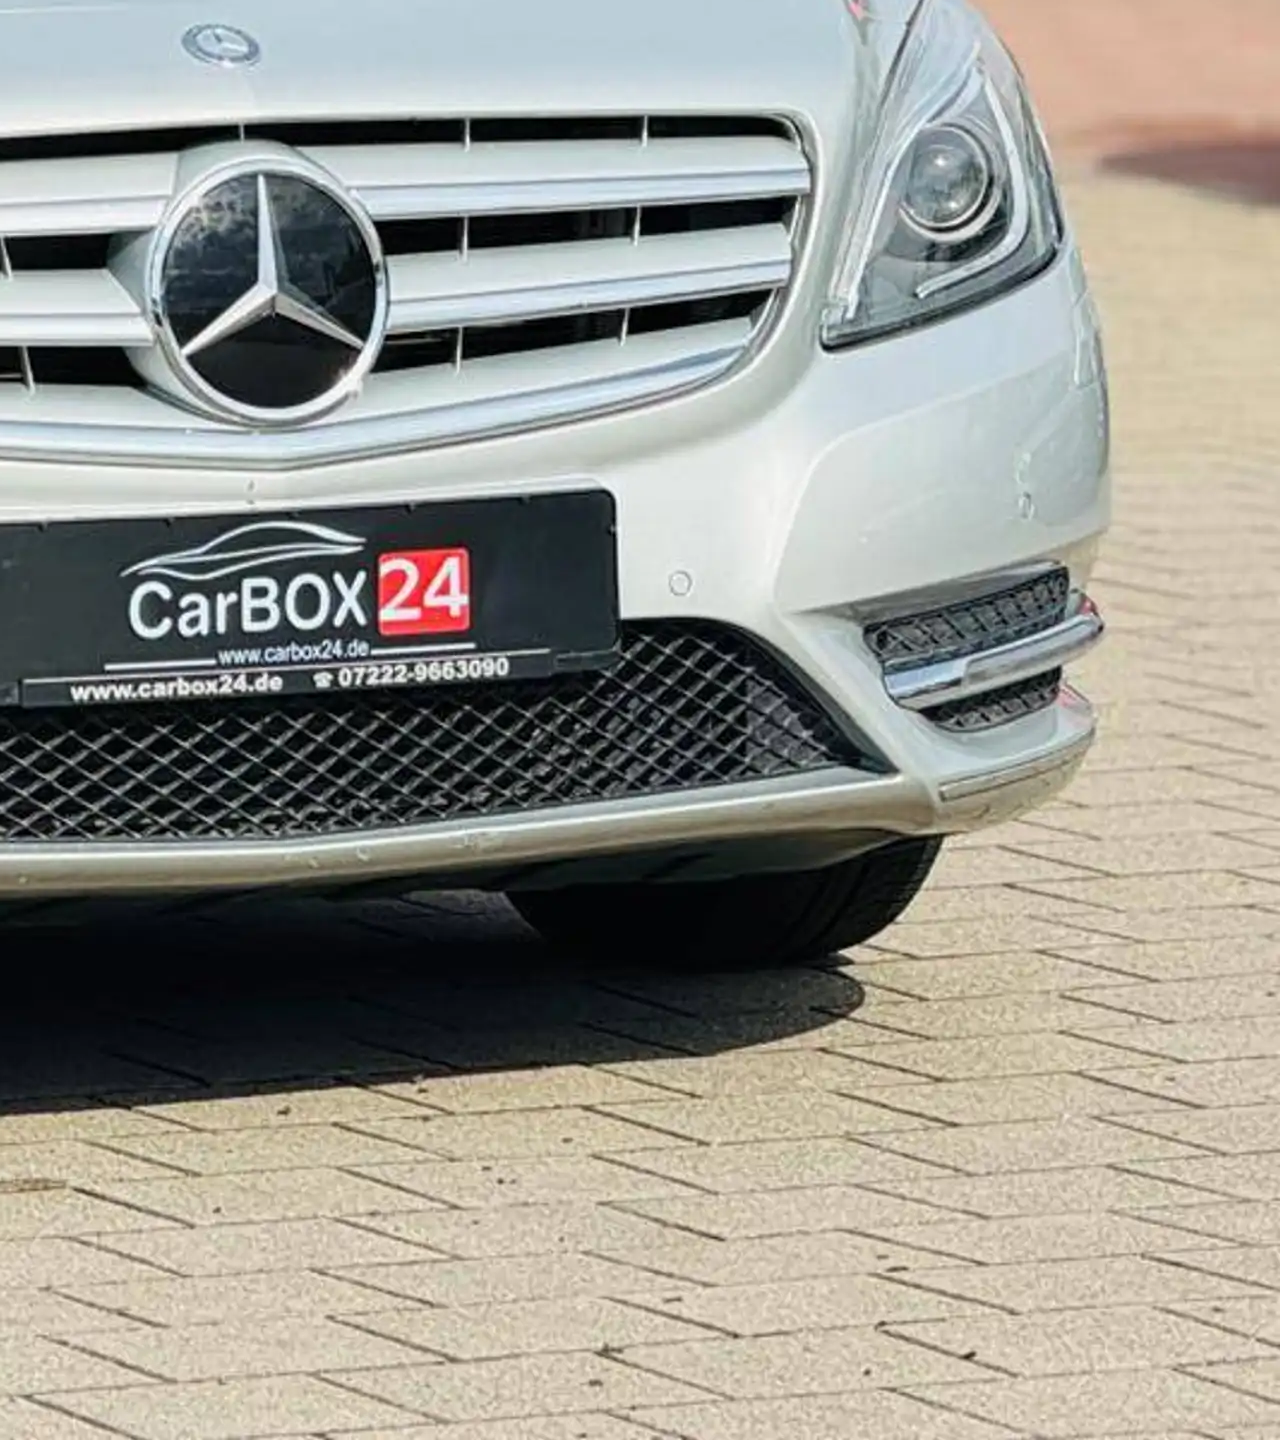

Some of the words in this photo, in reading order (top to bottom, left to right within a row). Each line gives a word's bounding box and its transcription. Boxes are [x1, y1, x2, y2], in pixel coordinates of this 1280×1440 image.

[218, 639, 370, 665] www.carbox24.de
[70, 672, 284, 702] www.carbox24.de
[338, 658, 510, 687] 07222-9663090
